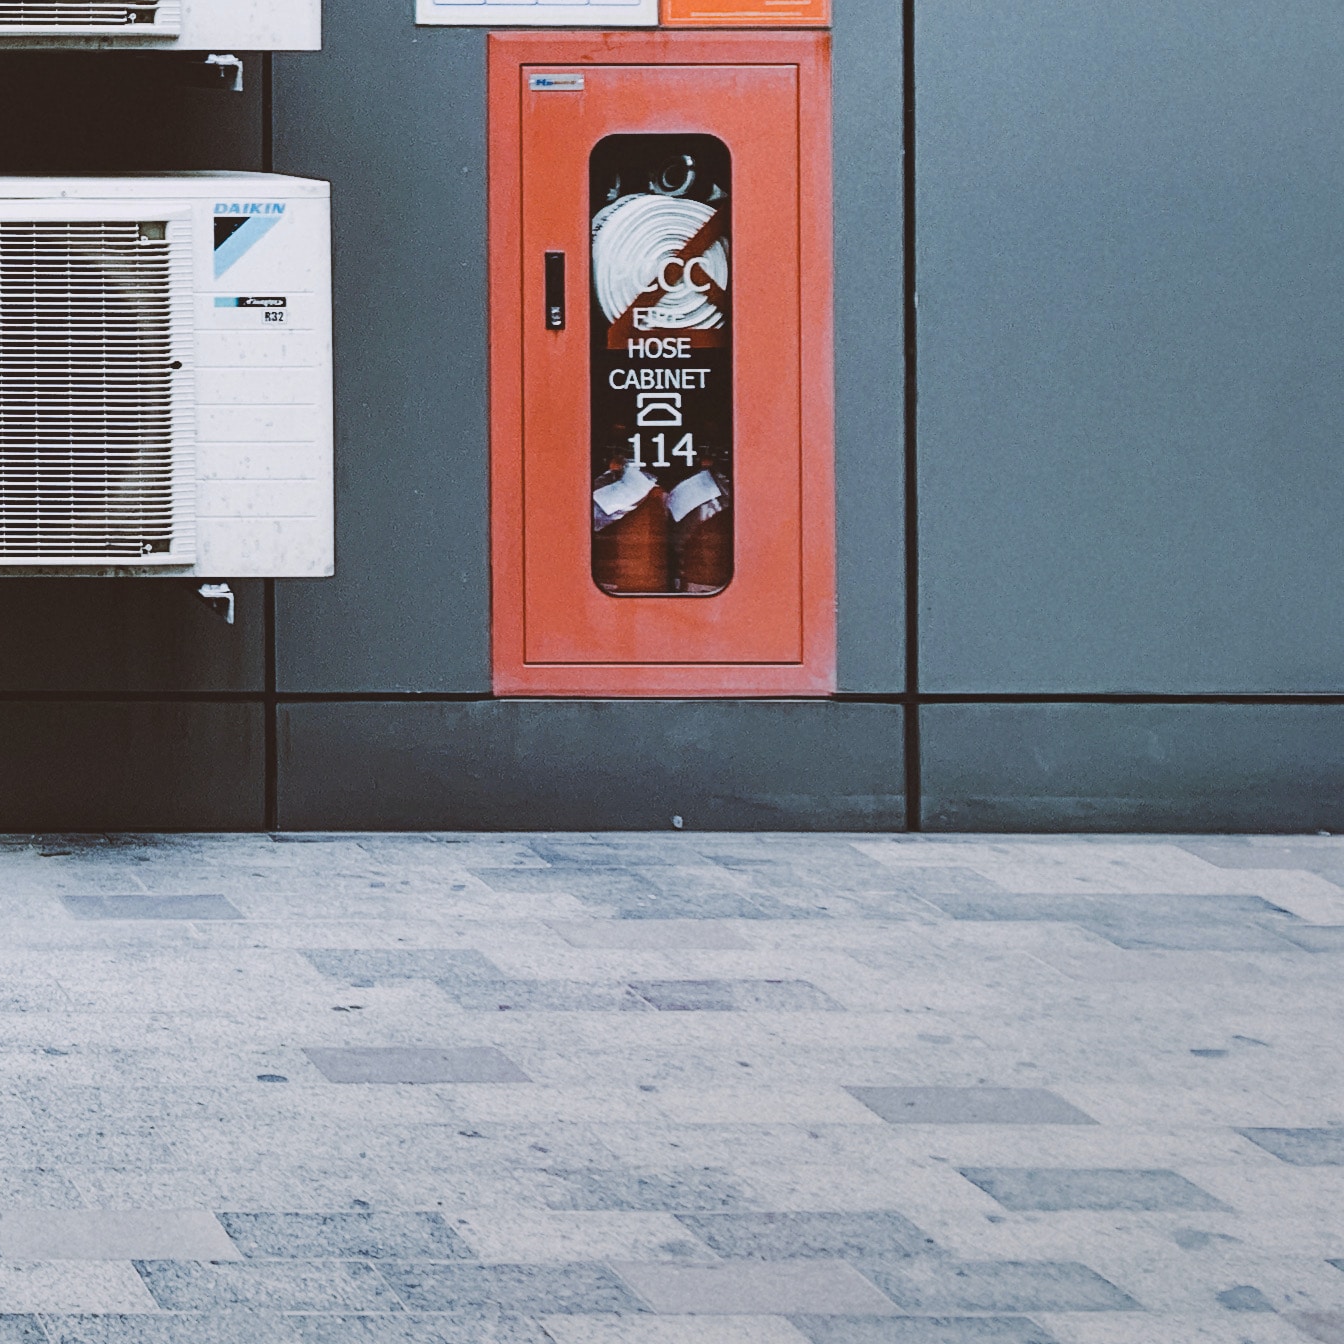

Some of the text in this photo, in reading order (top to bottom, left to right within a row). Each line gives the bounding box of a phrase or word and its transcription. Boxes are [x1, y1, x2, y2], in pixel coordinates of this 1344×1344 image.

[213, 203, 286, 214] DAIKIN
[264, 311, 284, 322] R32
[628, 337, 692, 358] HOSE
[608, 368, 711, 389] CABINET
[627, 432, 697, 467] 114
